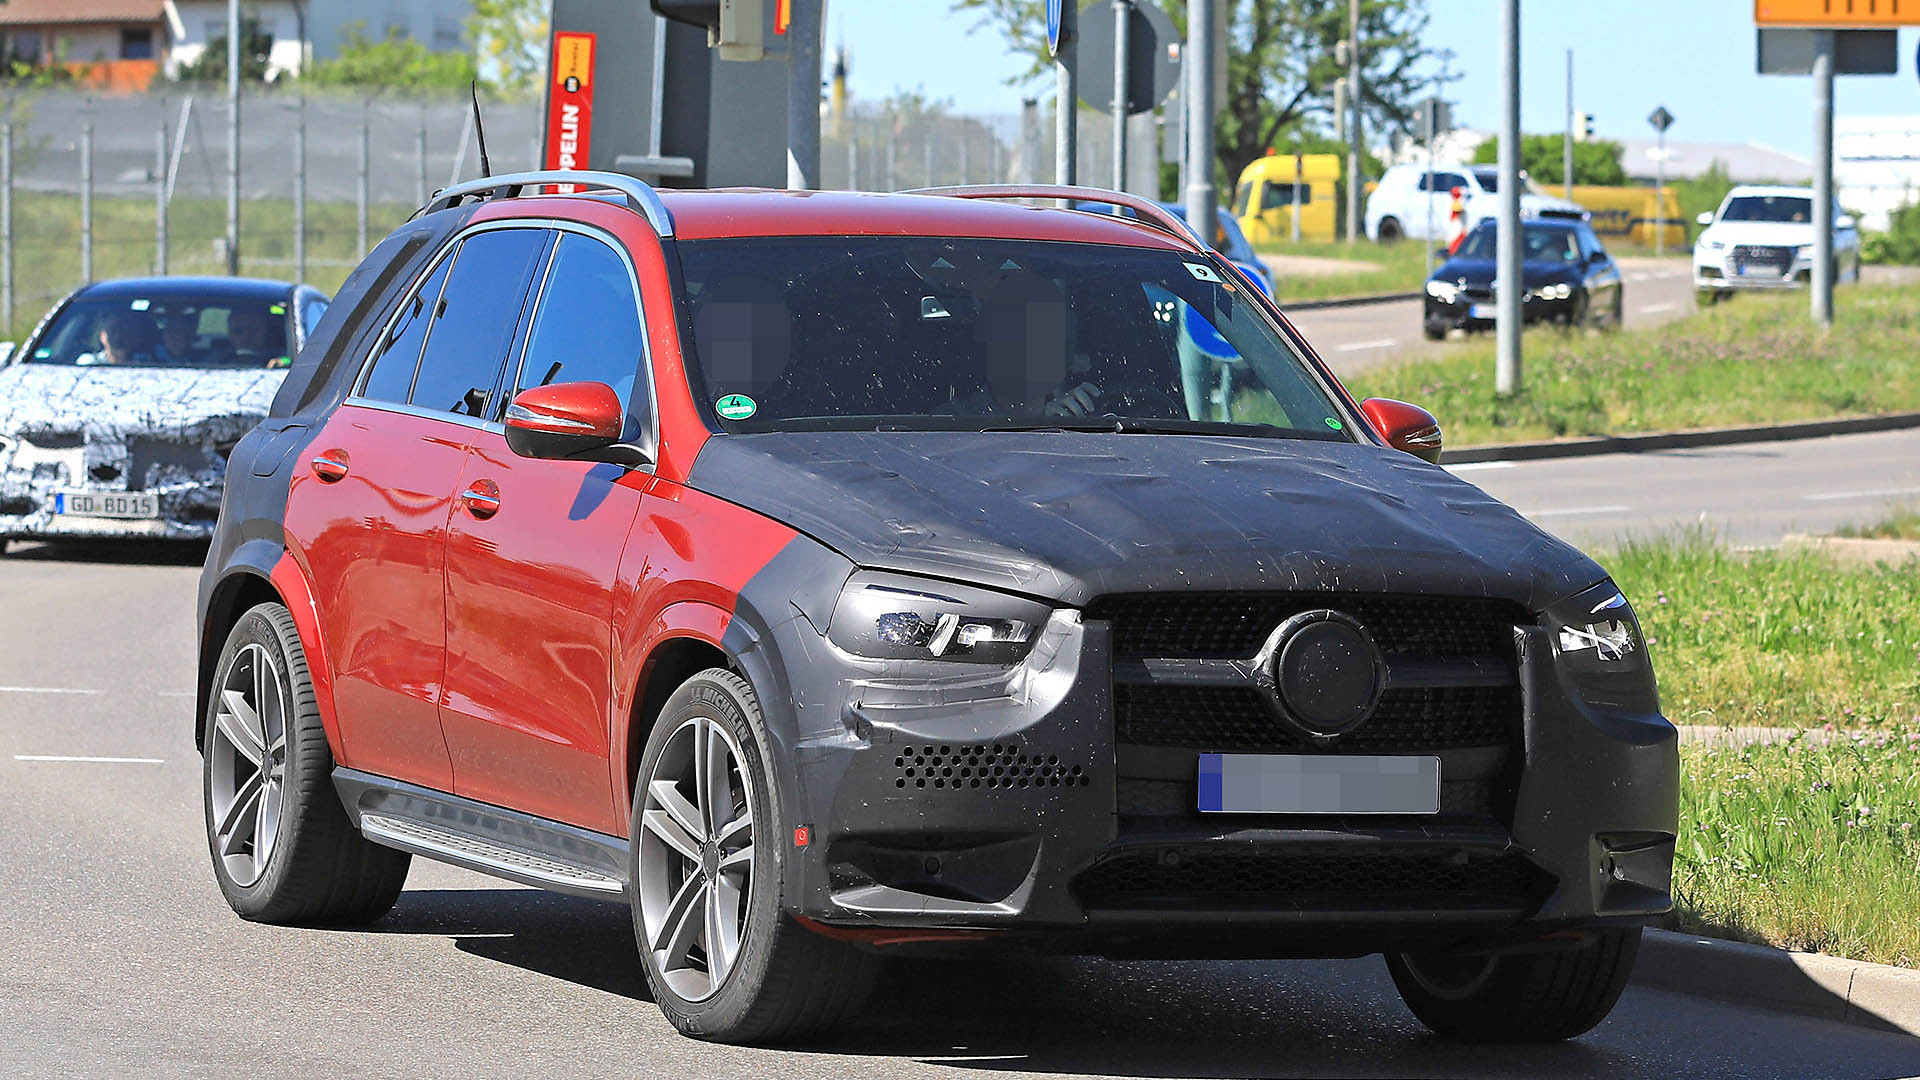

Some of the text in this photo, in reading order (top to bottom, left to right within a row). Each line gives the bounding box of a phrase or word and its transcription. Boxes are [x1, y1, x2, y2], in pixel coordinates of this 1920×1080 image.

[557, 103, 580, 194] EPELIN
[730, 396, 741, 407] 4
[72, 497, 93, 513] GD
[702, 687, 748, 742] MICHELIN
